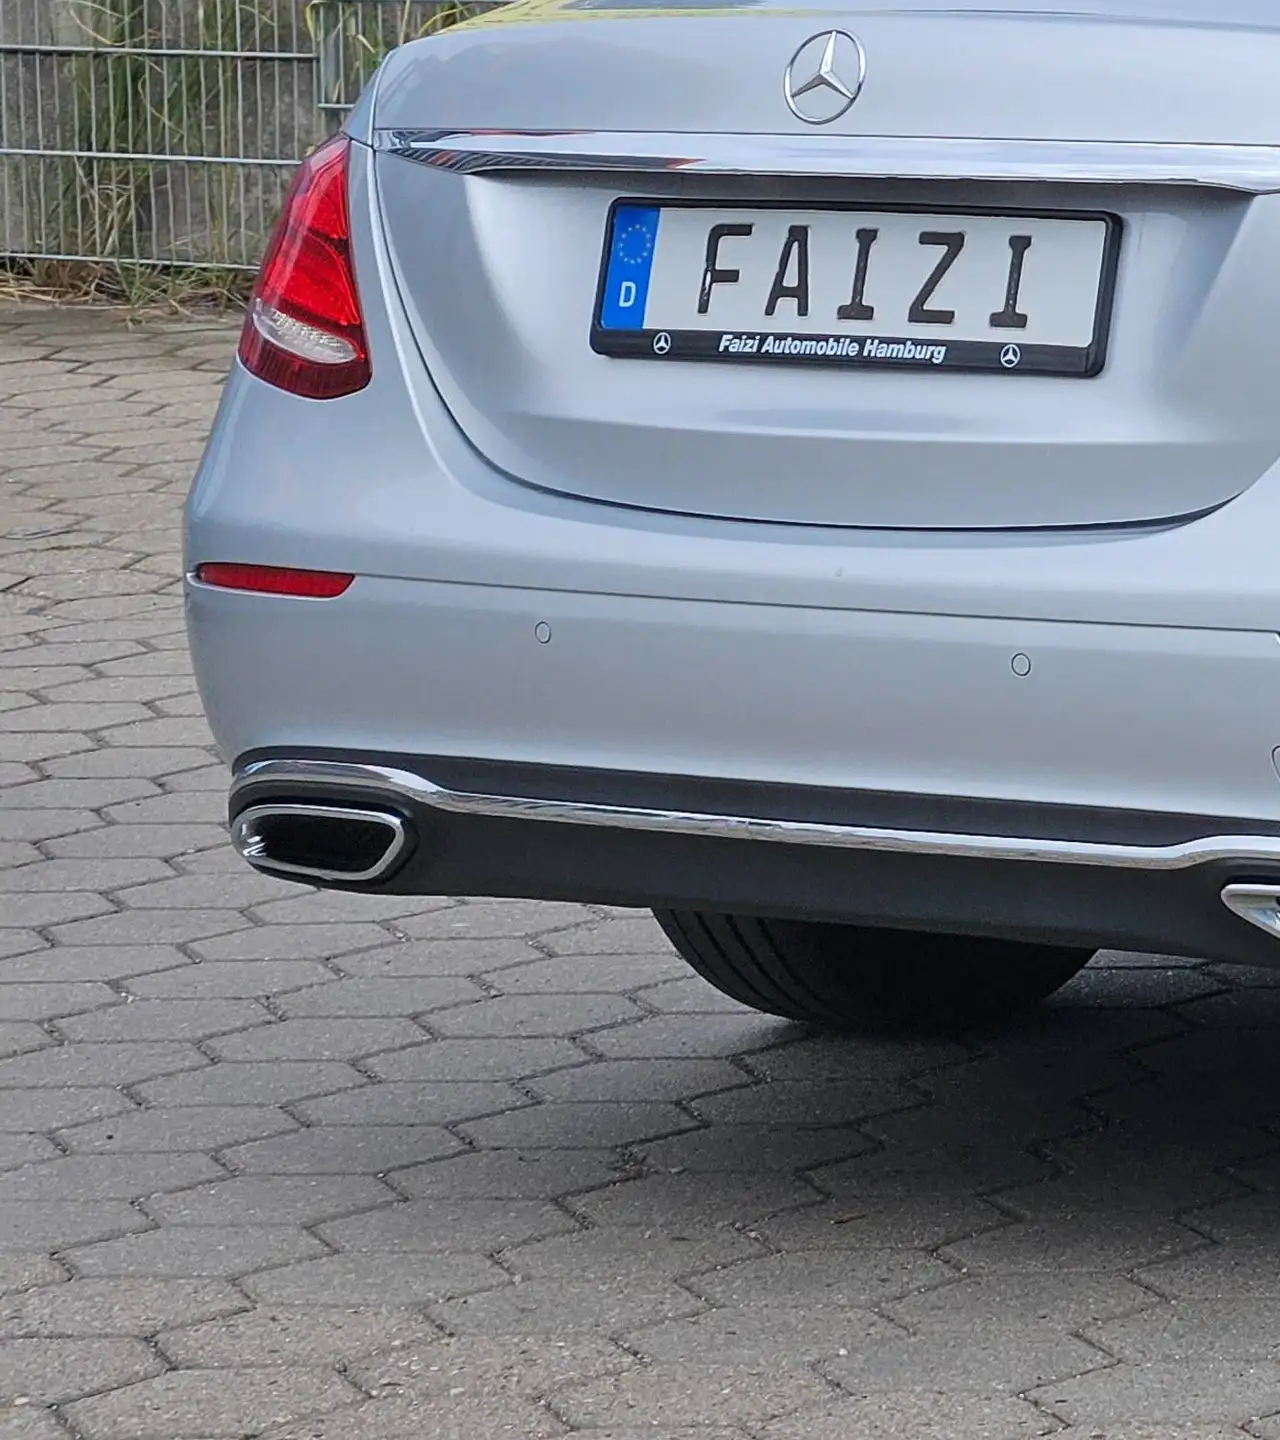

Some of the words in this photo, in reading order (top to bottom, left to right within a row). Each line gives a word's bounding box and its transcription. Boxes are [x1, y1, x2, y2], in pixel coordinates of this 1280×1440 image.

[697, 222, 1033, 328] FAIZI
[618, 280, 637, 308] D
[718, 334, 760, 353] Faizi
[760, 335, 860, 357] Automobile
[862, 338, 948, 364] Hamburg
